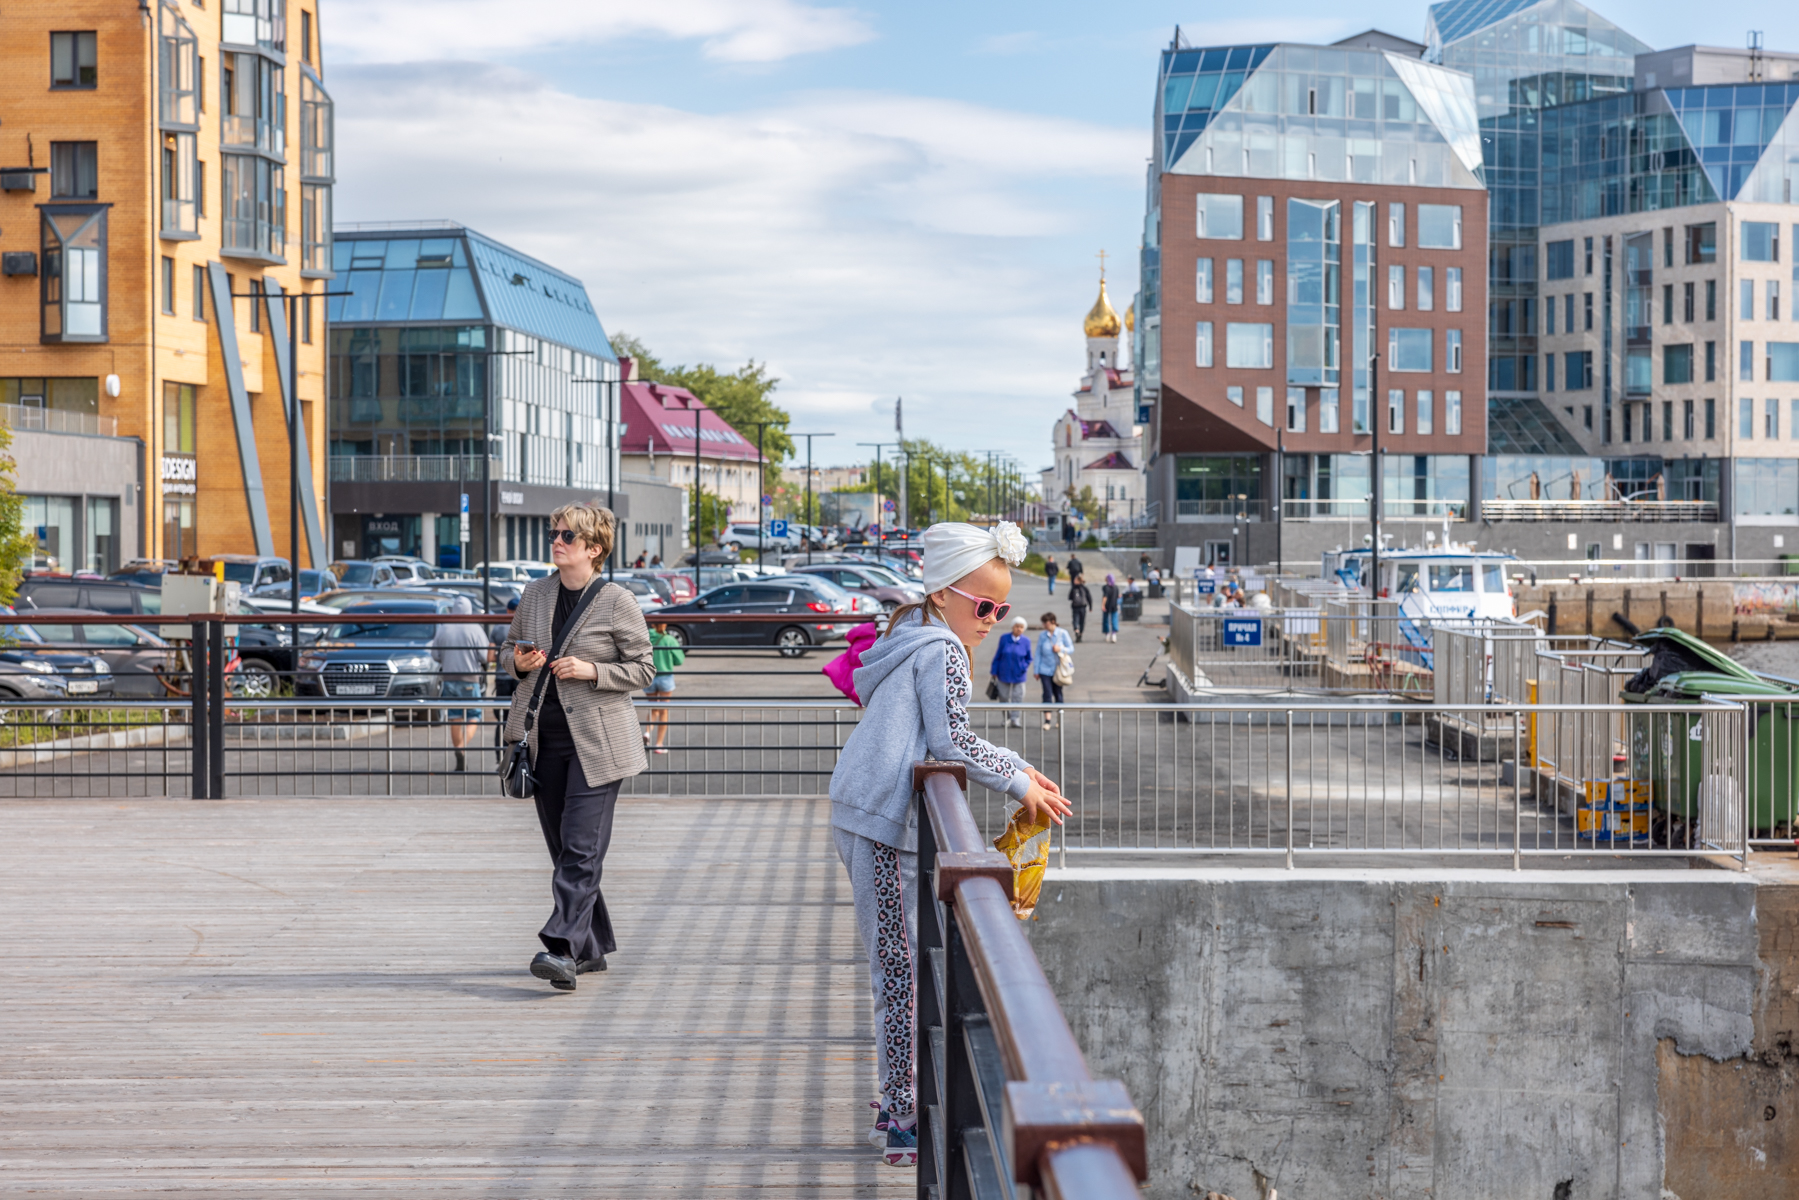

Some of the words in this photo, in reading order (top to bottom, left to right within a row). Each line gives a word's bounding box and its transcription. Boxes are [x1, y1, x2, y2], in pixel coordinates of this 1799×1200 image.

[369, 521, 399, 531] ВХОД
[774, 521, 784, 535] P
[1228, 622, 1257, 632] ПРИЧАЛ
